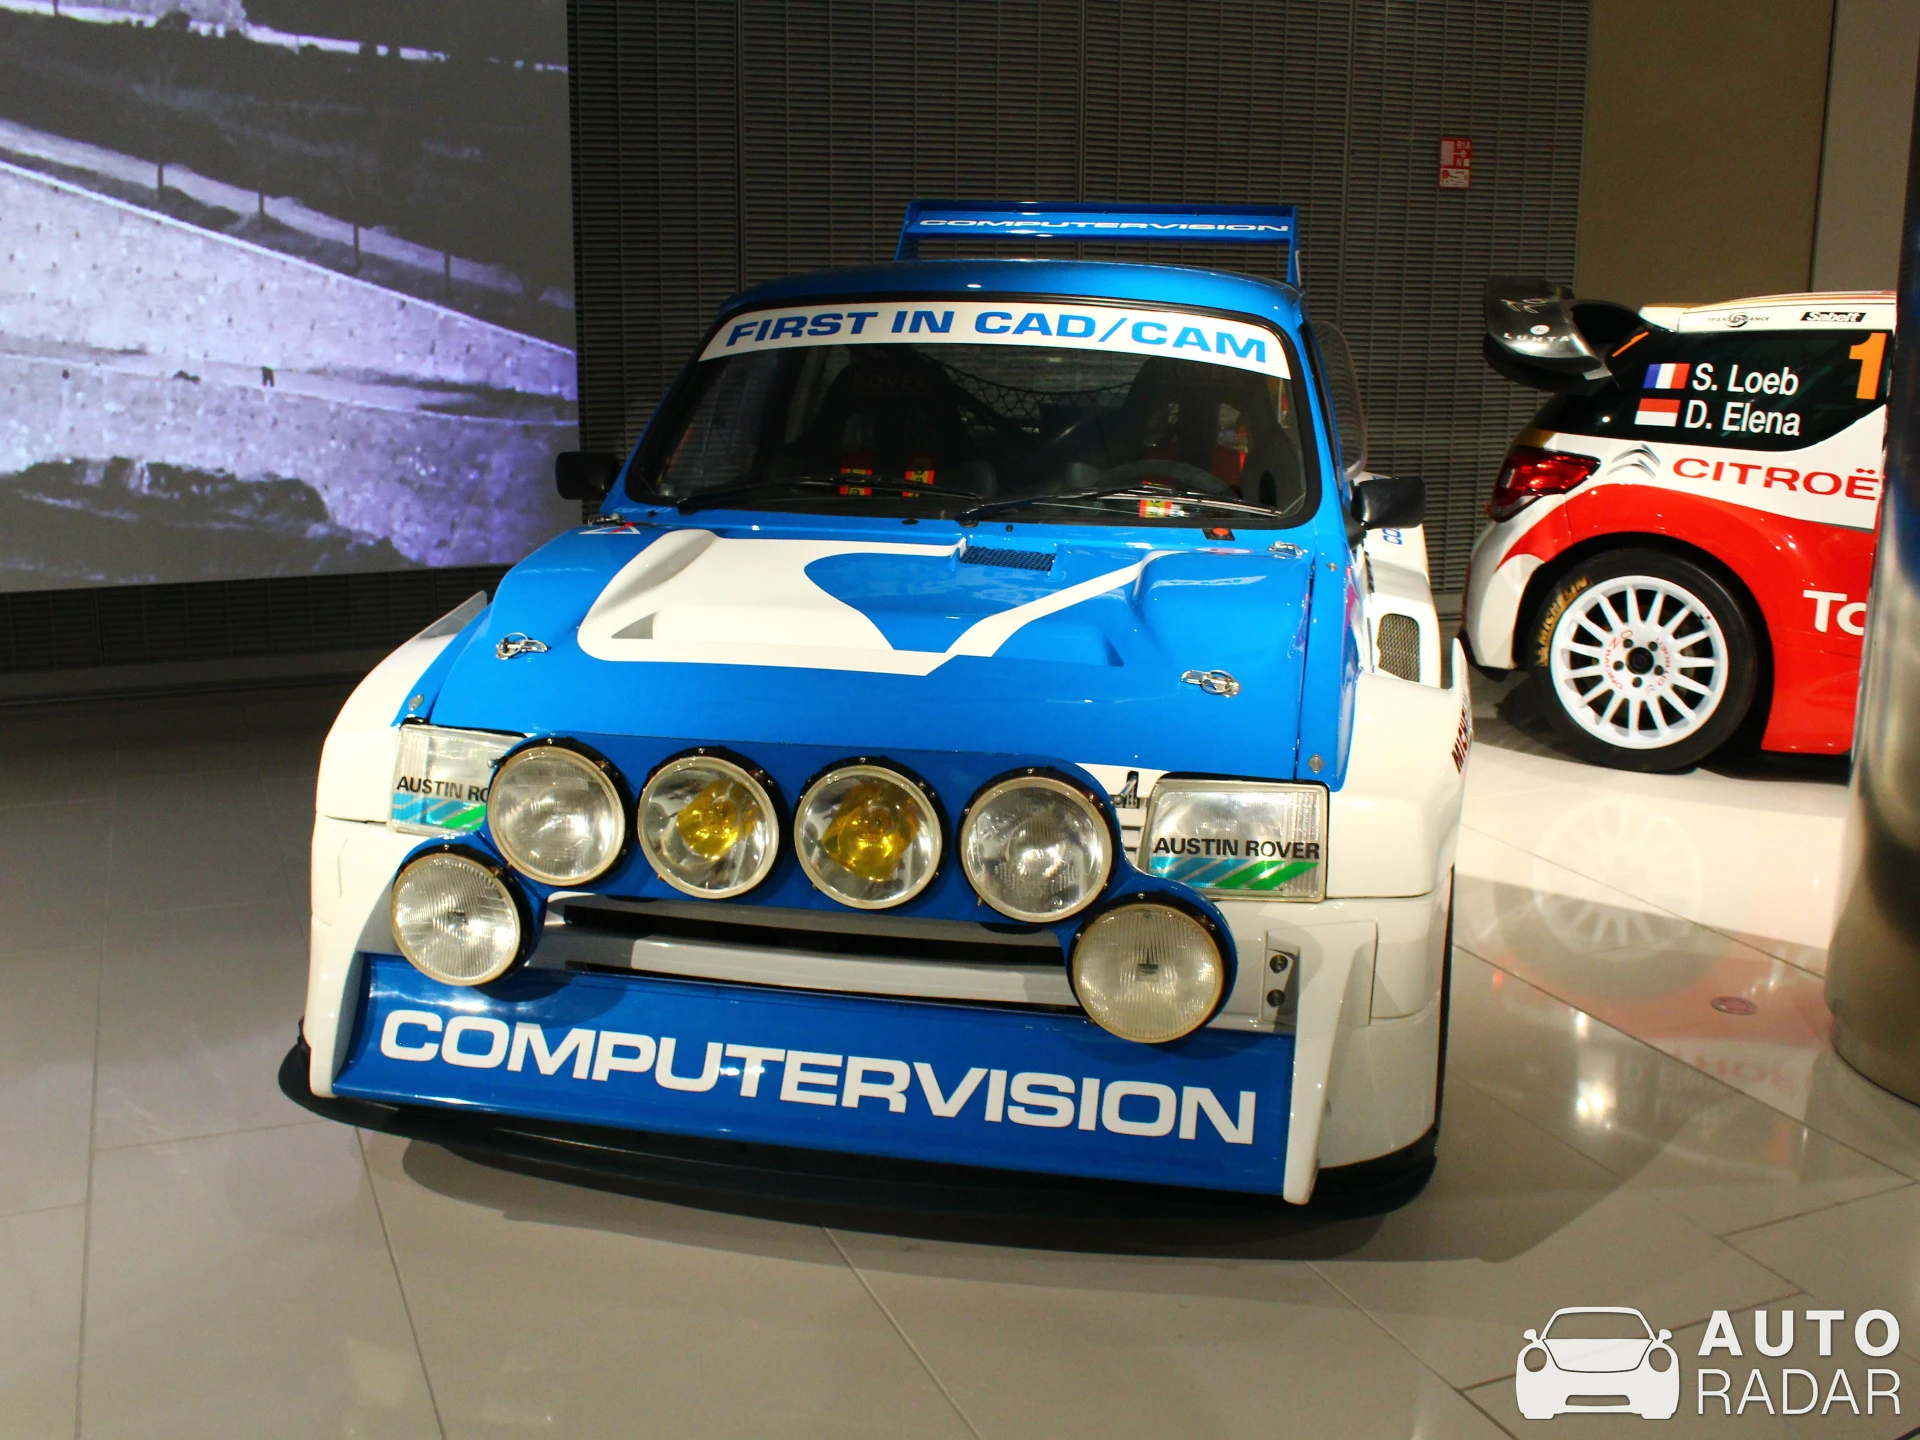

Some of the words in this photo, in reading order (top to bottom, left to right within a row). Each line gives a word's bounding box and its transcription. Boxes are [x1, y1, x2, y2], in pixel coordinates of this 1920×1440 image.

[919, 219, 1290, 233] COMPUTERVISION
[1805, 311, 1861, 322] Sabelt
[725, 311, 878, 347] FIRST
[891, 310, 955, 334] IN
[974, 311, 1268, 364] CAD/CAM
[1503, 332, 1570, 342] LUHTA
[1692, 363, 1718, 391] S.
[1727, 365, 1800, 396] Loeb
[1848, 332, 1888, 400] 1
[1684, 401, 1713, 430] D.
[1722, 402, 1801, 436] Elena
[396, 776, 464, 799] AUSTIN
[1153, 837, 1239, 856] AUSTIN
[1245, 840, 1320, 859] ROVER
[380, 1010, 1256, 1145] COMPUTERVISION
